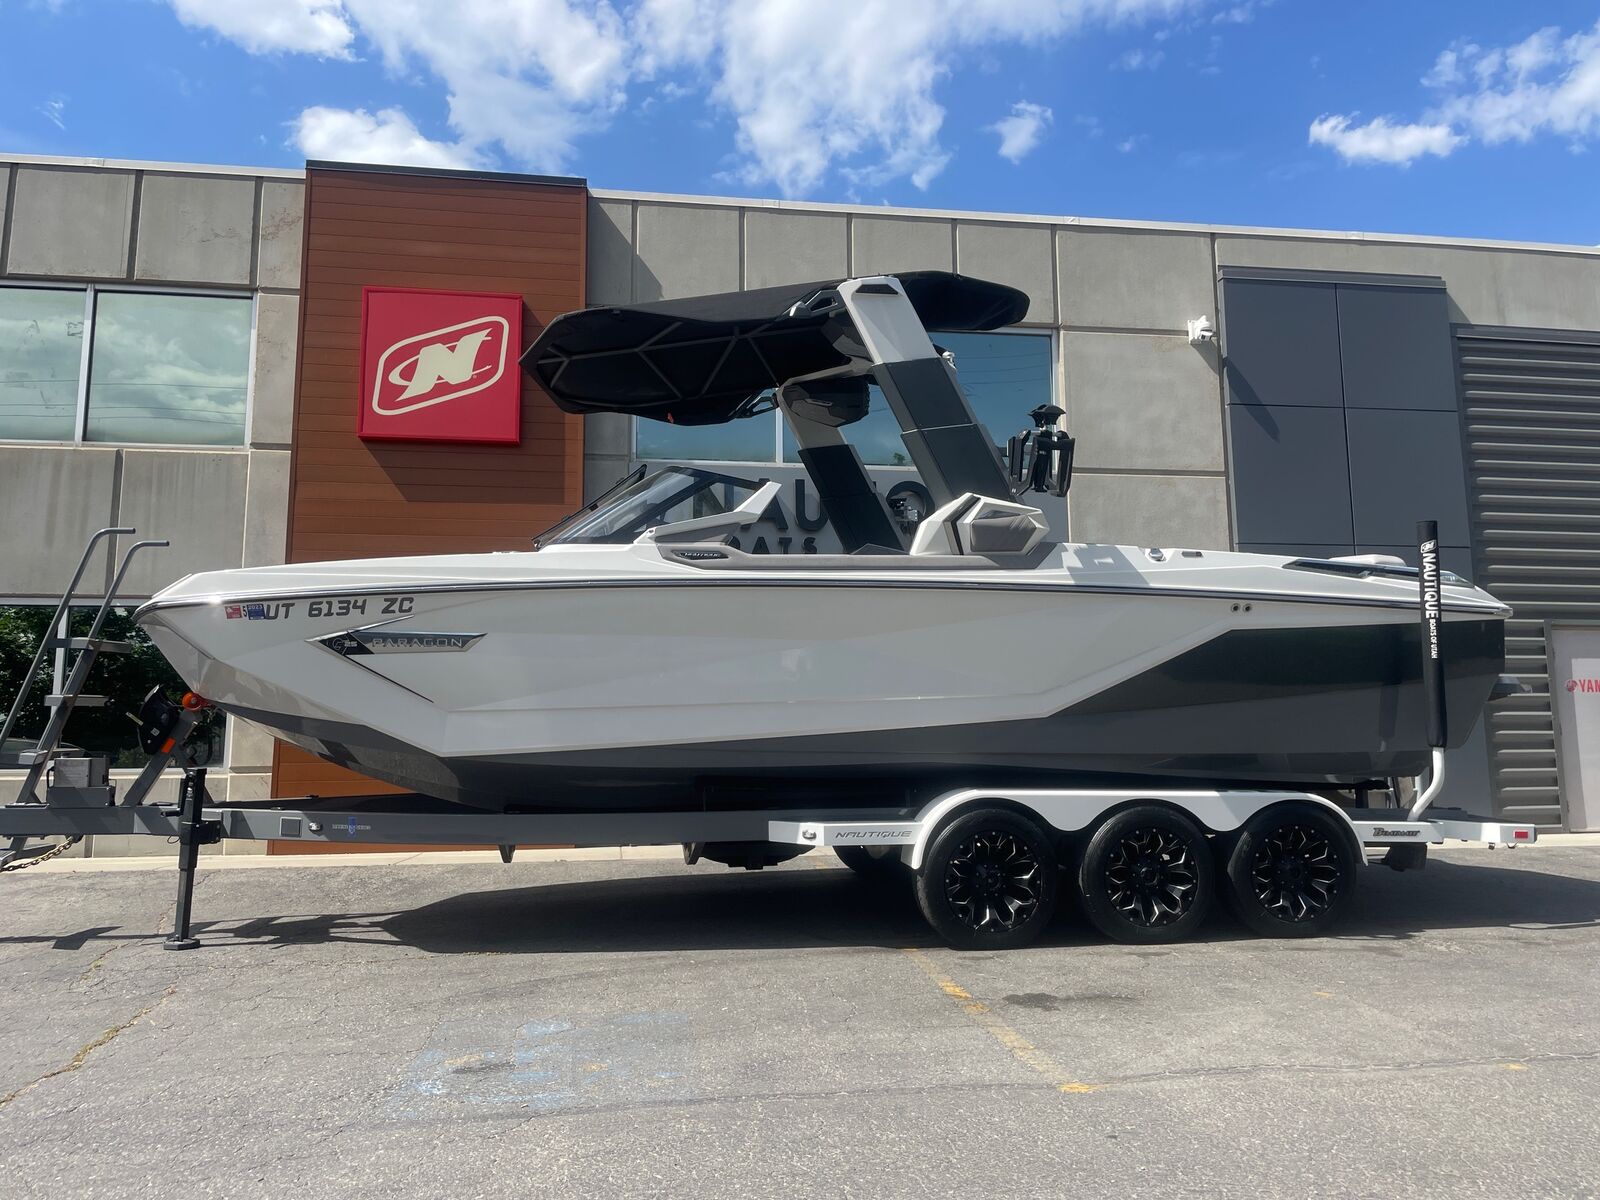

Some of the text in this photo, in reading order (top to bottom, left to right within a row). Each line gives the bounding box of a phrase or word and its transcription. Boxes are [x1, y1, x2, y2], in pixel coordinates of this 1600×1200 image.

[1423, 553, 1438, 618] NAUTIQUE
[265, 597, 415, 620] UT 6134 ZC
[371, 638, 463, 648] PARAGON
